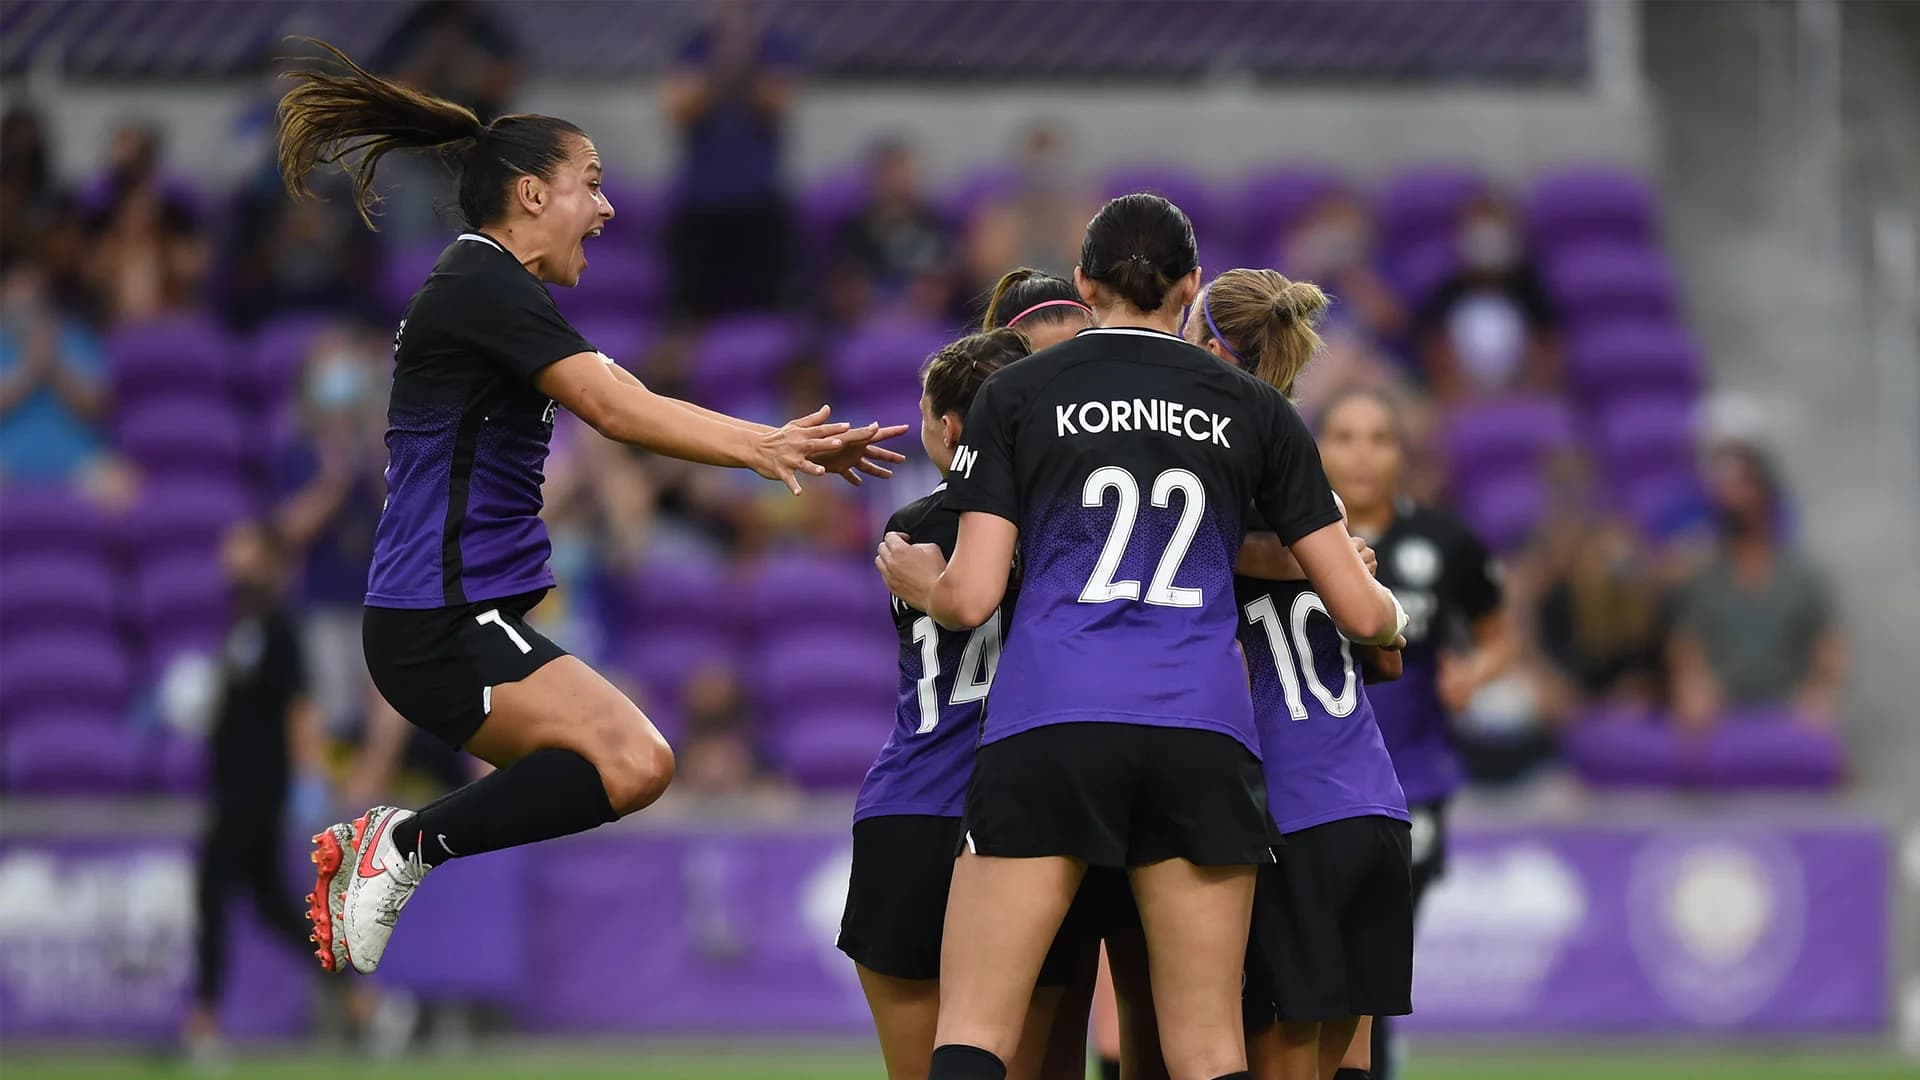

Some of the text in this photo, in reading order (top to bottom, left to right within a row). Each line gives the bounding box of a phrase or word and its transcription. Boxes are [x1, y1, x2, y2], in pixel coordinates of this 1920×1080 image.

[1056, 398, 1232, 449] KORNIECK
[1077, 466, 1206, 607] 22
[475, 608, 532, 654] 7
[912, 606, 1003, 734] 14
[1244, 591, 1357, 721] 10
